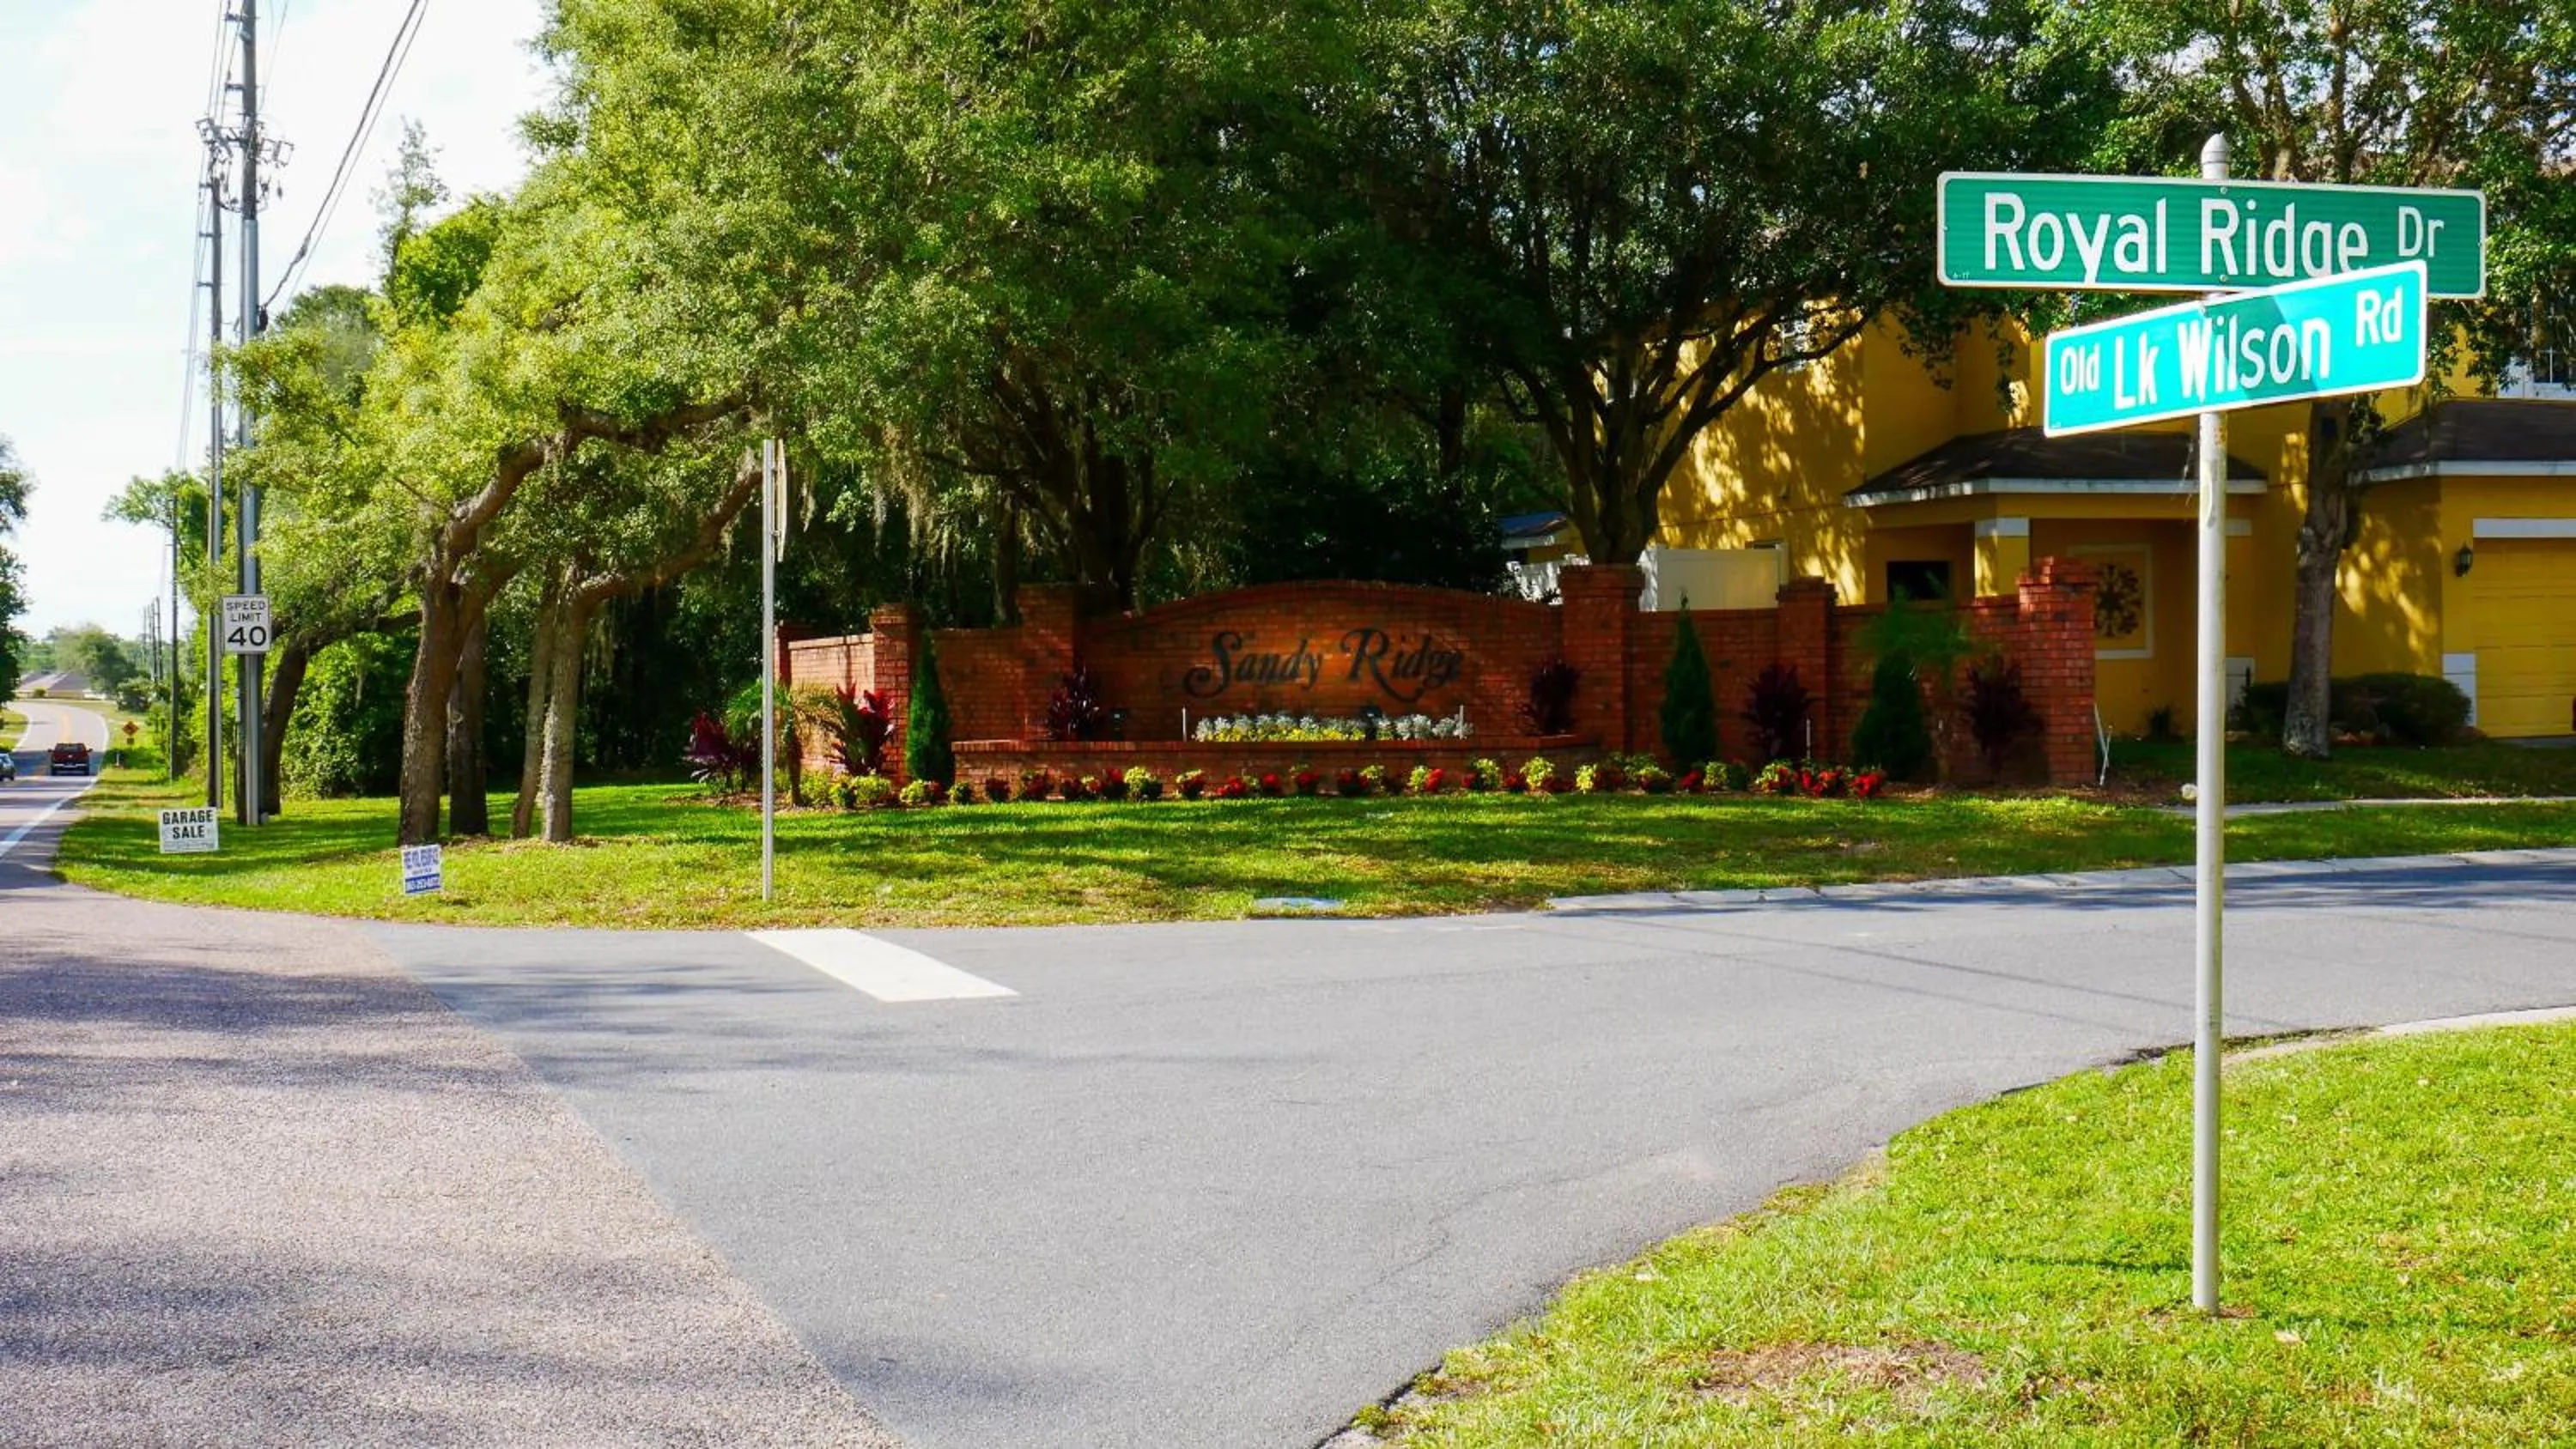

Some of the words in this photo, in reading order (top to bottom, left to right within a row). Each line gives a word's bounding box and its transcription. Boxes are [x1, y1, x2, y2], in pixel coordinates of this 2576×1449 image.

[1984, 191, 2166, 283] Royal
[2201, 198, 2369, 277] Ridge
[2398, 206, 2445, 258] Dr
[2061, 343, 2100, 395] Old
[2114, 331, 2159, 410] Lk
[2178, 317, 2330, 401] Wilson
[2355, 287, 2403, 347] Rd
[227, 600, 266, 610] SPEED
[230, 612, 261, 622] LIMIT
[228, 626, 266, 646] 40
[1182, 631, 1323, 699] Sandy
[1340, 627, 1464, 703] Ridge
[162, 809, 214, 825] GARAGE
[173, 825, 204, 840] SALE
